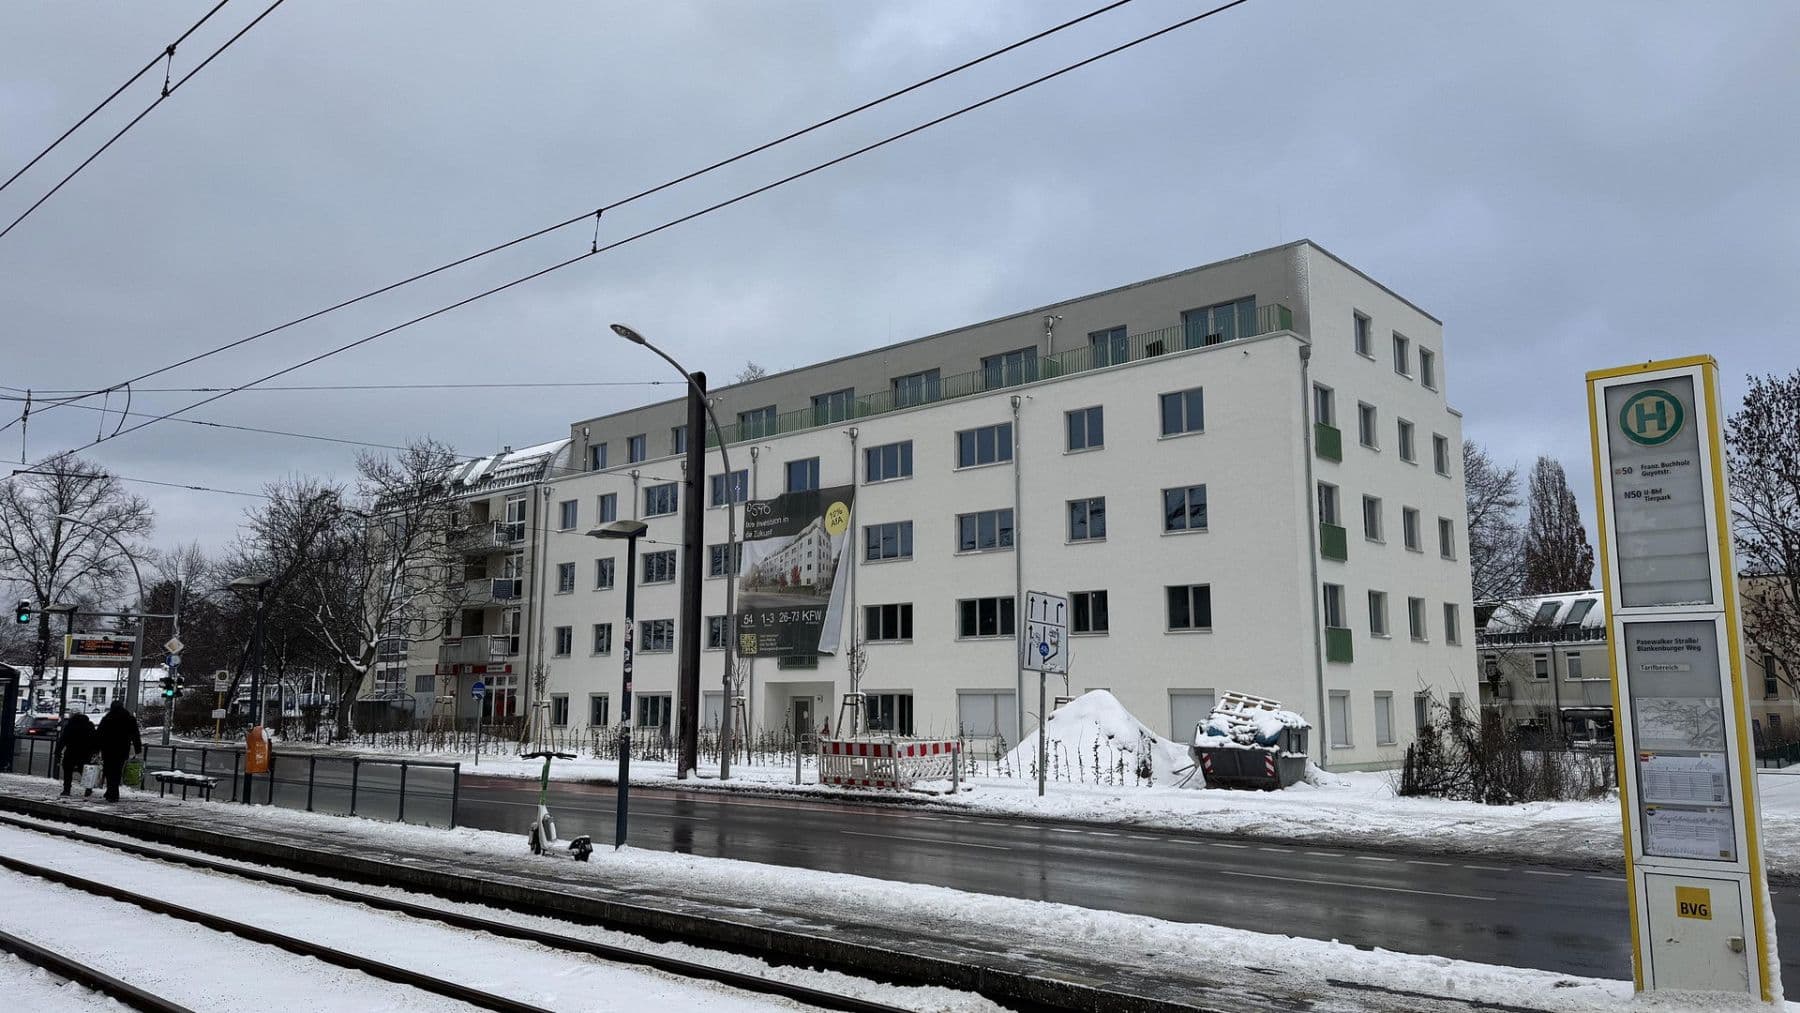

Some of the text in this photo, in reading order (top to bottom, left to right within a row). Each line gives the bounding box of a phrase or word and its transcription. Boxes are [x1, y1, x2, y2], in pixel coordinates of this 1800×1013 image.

[1635, 400, 1667, 433] H
[1660, 459, 1690, 469] Buchholz
[1622, 466, 1633, 475] 50
[1624, 490, 1642, 499] N50
[1644, 494, 1671, 502] Tierpark
[743, 613, 753, 625] 54
[1685, 644, 1702, 652] Weg
[1680, 901, 1708, 917] BVG
